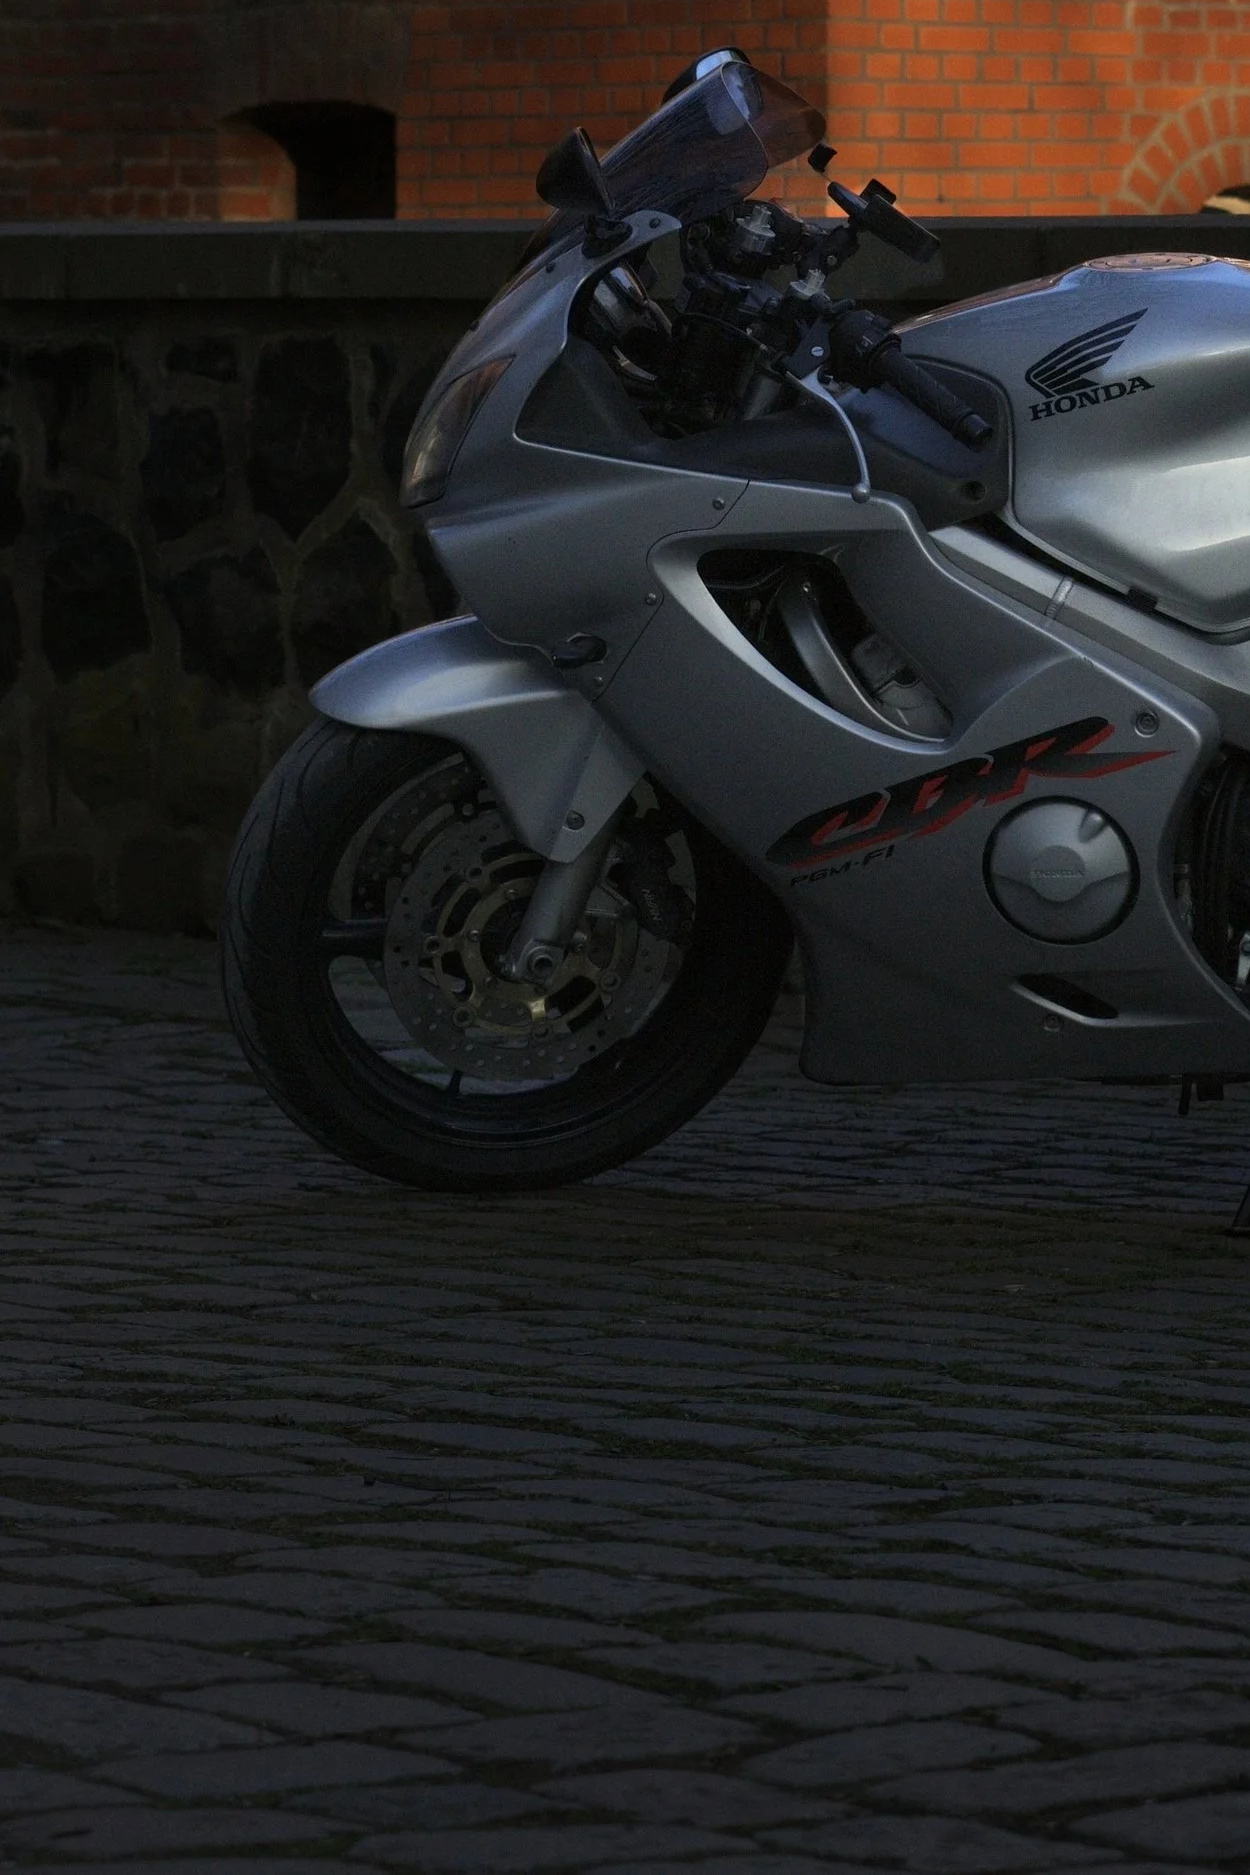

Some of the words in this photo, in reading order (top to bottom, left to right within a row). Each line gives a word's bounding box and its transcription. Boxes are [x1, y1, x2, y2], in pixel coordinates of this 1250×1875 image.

[1028, 375, 1155, 422] HONDA
[765, 716, 1178, 869] CBR
[790, 844, 895, 886] PGM-FI
